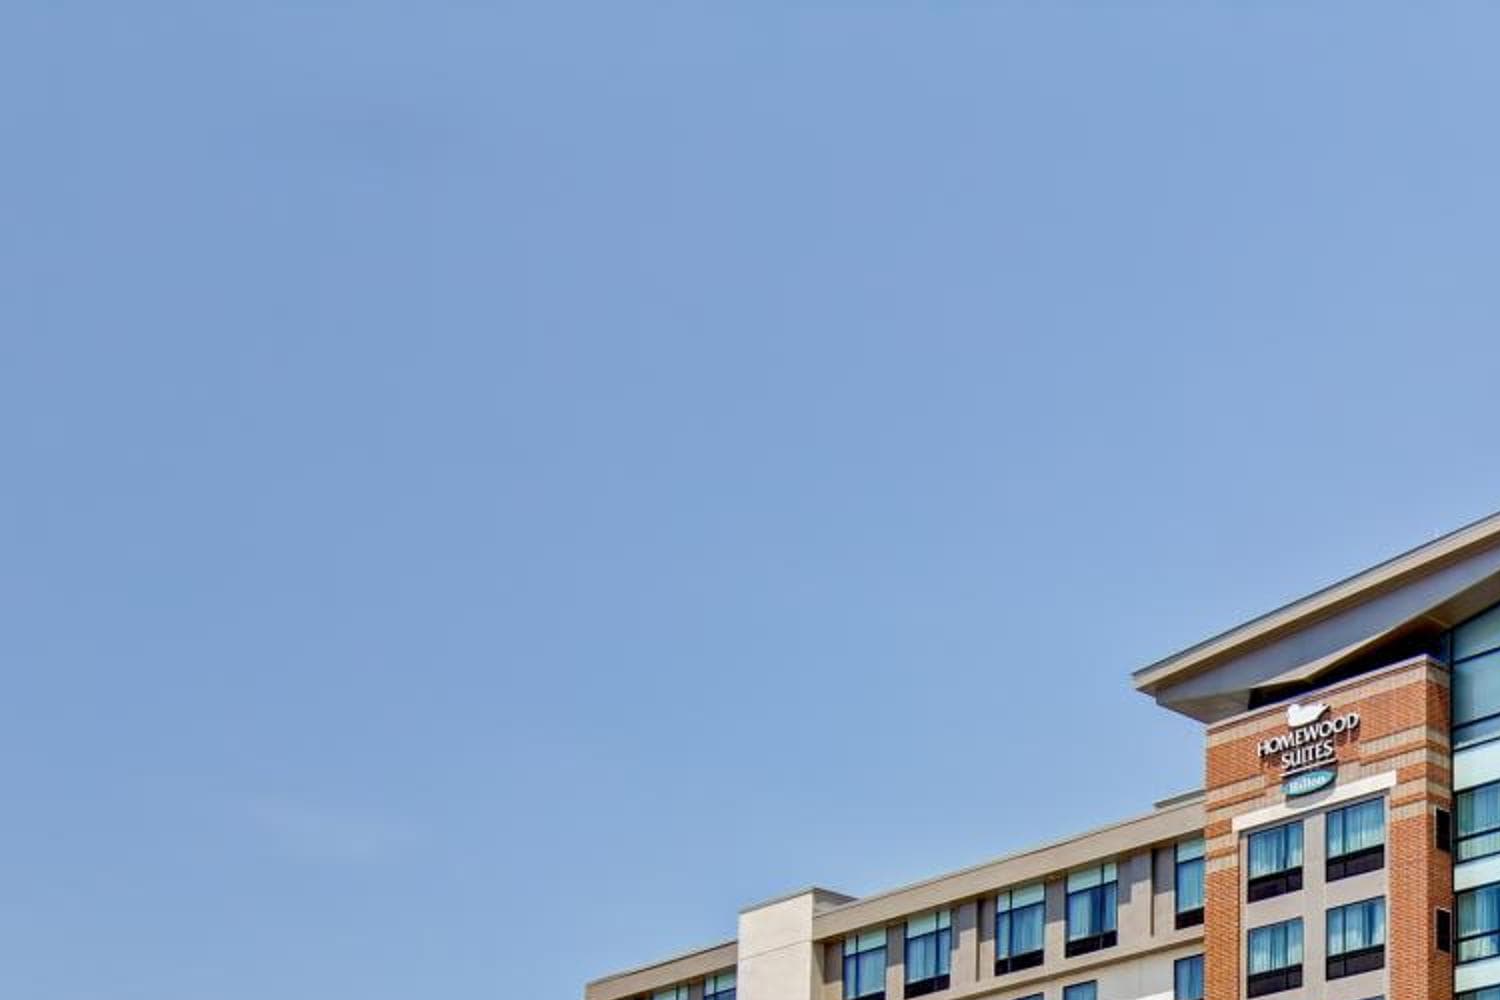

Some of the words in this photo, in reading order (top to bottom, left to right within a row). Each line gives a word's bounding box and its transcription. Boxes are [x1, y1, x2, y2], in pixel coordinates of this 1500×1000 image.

[1257, 713, 1360, 757] HOMEWOOD
[1281, 739, 1334, 769] SUITES
[1289, 775, 1327, 793] Hilton
